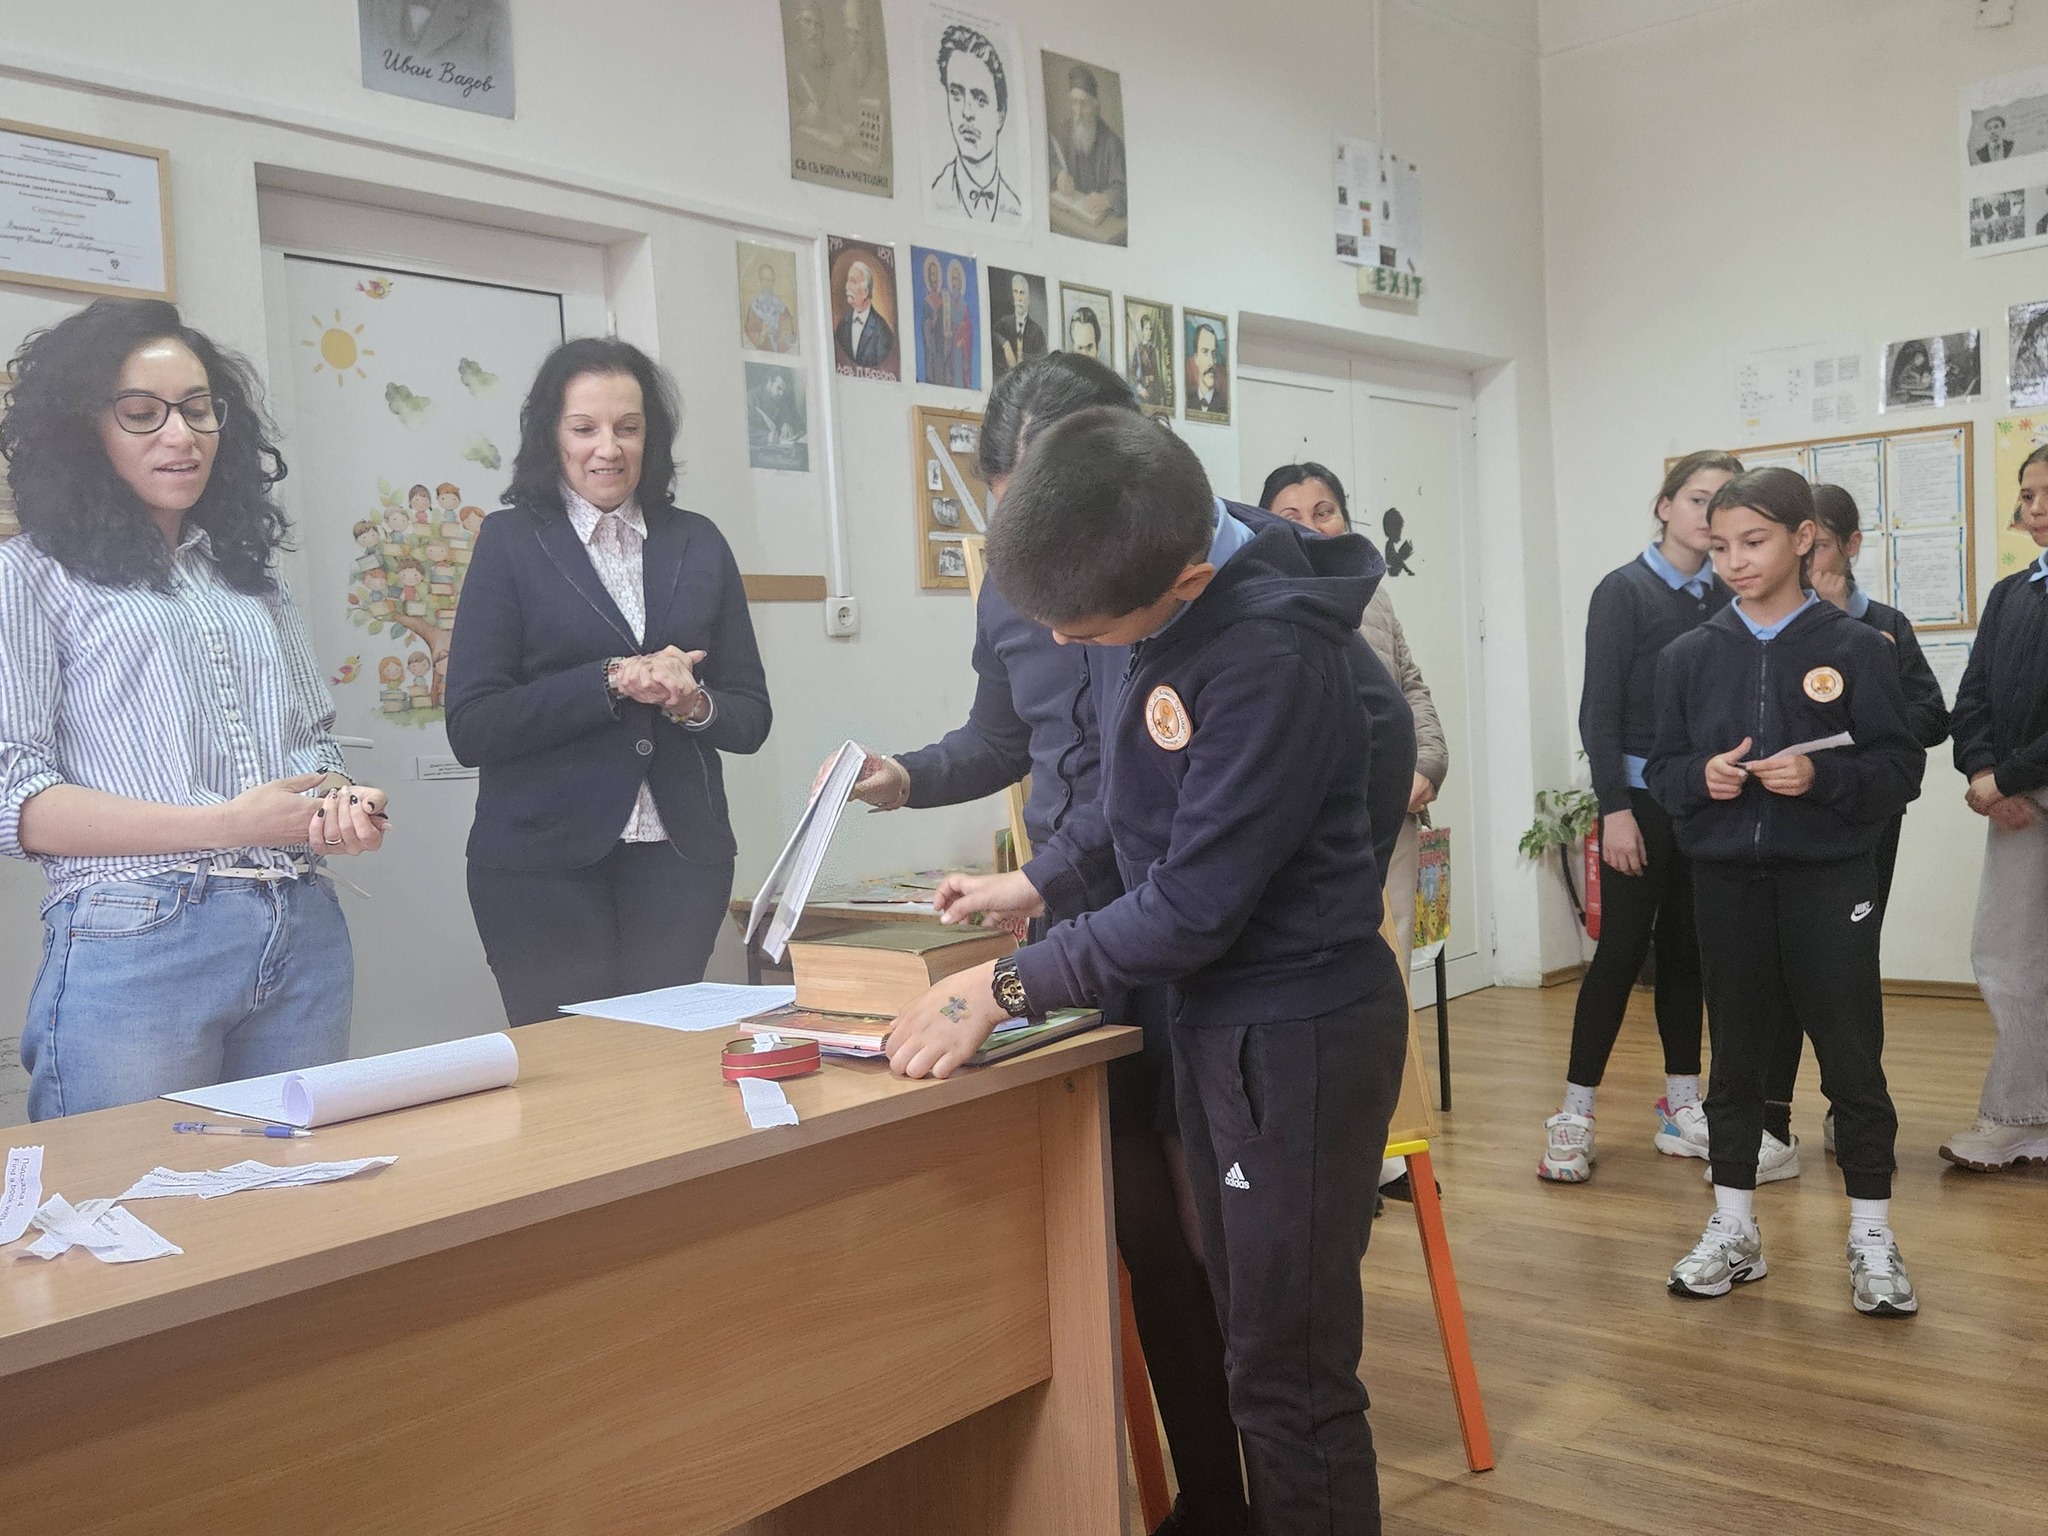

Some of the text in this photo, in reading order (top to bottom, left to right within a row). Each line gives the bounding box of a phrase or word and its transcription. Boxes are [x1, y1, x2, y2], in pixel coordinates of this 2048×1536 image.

[383, 48, 495, 98] Иван Вазов
[1376, 267, 1422, 299] EXIT
[10, 1157, 19, 1176] Find
[20, 1157, 30, 1200] Подсказка
[8, 1184, 17, 1203] book
[1225, 1176, 1250, 1190] adidas
